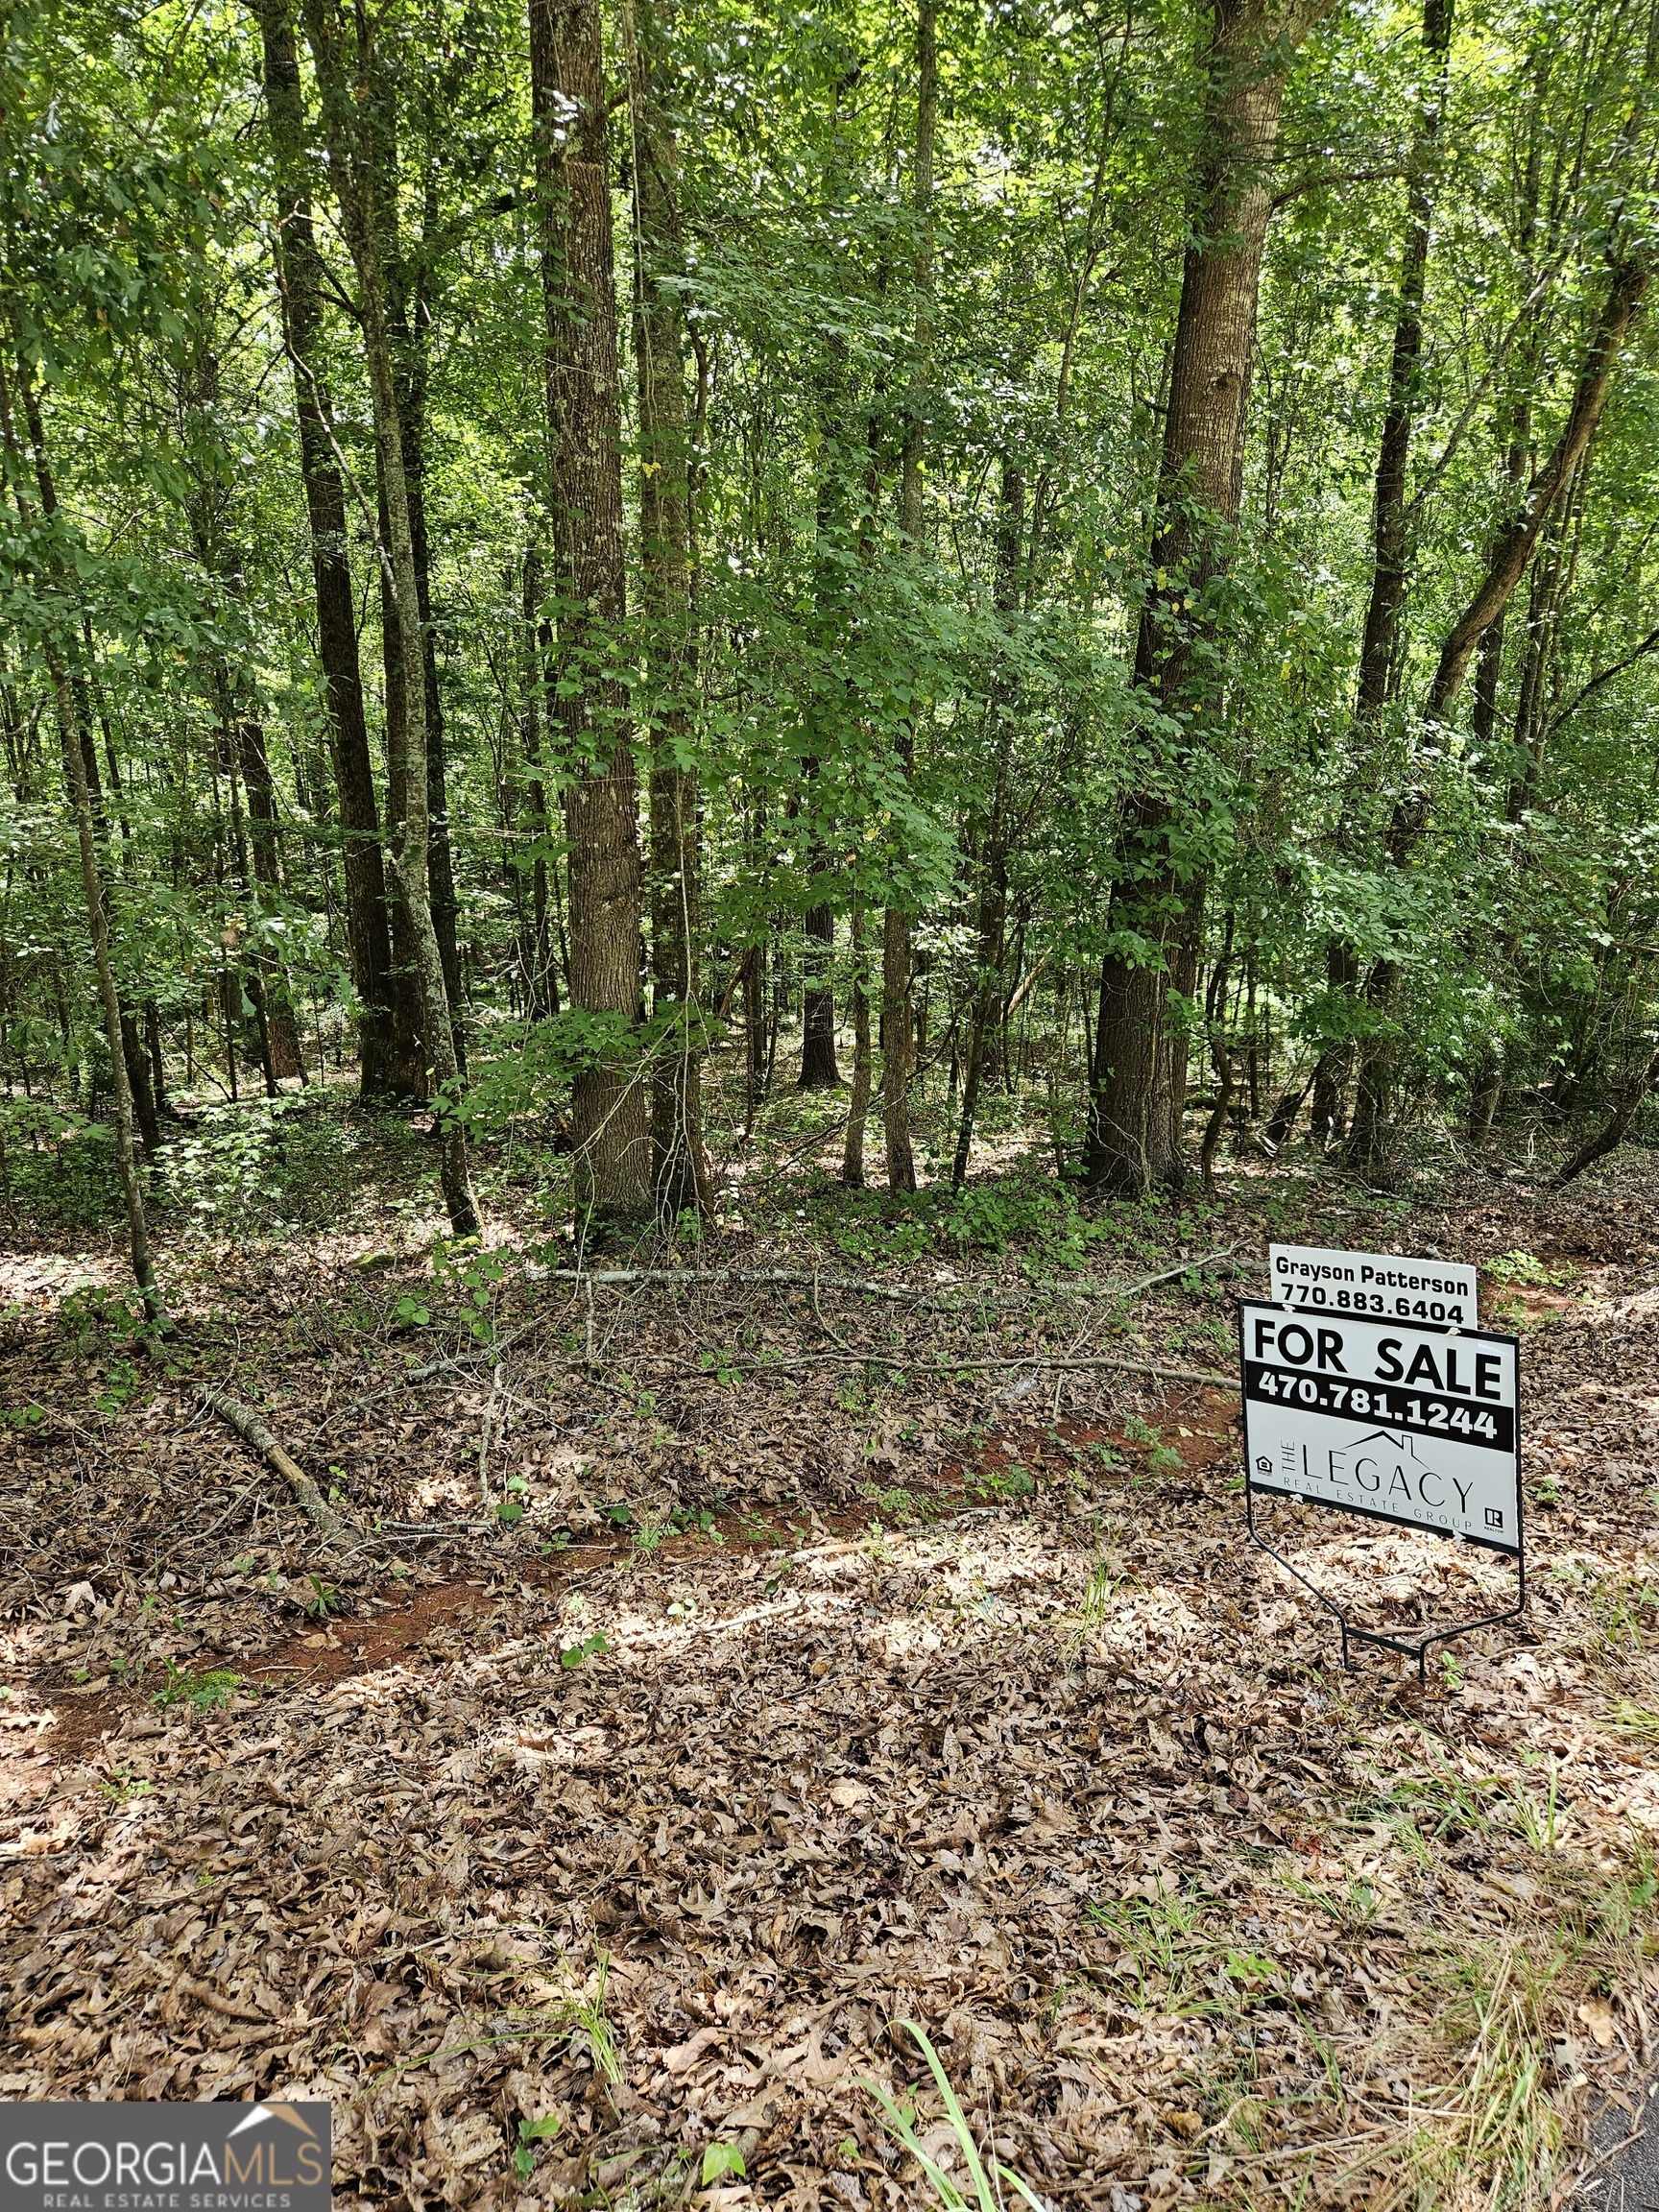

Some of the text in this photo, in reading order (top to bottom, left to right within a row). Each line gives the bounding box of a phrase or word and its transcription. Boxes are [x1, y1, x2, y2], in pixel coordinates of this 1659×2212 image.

[1276, 1256, 1469, 1296] Grayson Patterson
[1281, 1283, 1464, 1324] 770.883.6404
[1255, 1318, 1502, 1401] FOR SALE
[1259, 1371, 1498, 1439] 470.781.1244
[1281, 1440, 1295, 1472] THE
[1303, 1444, 1474, 1514] LEGACY
[1284, 1477, 1473, 1531] REAL ESTATE GROUP
